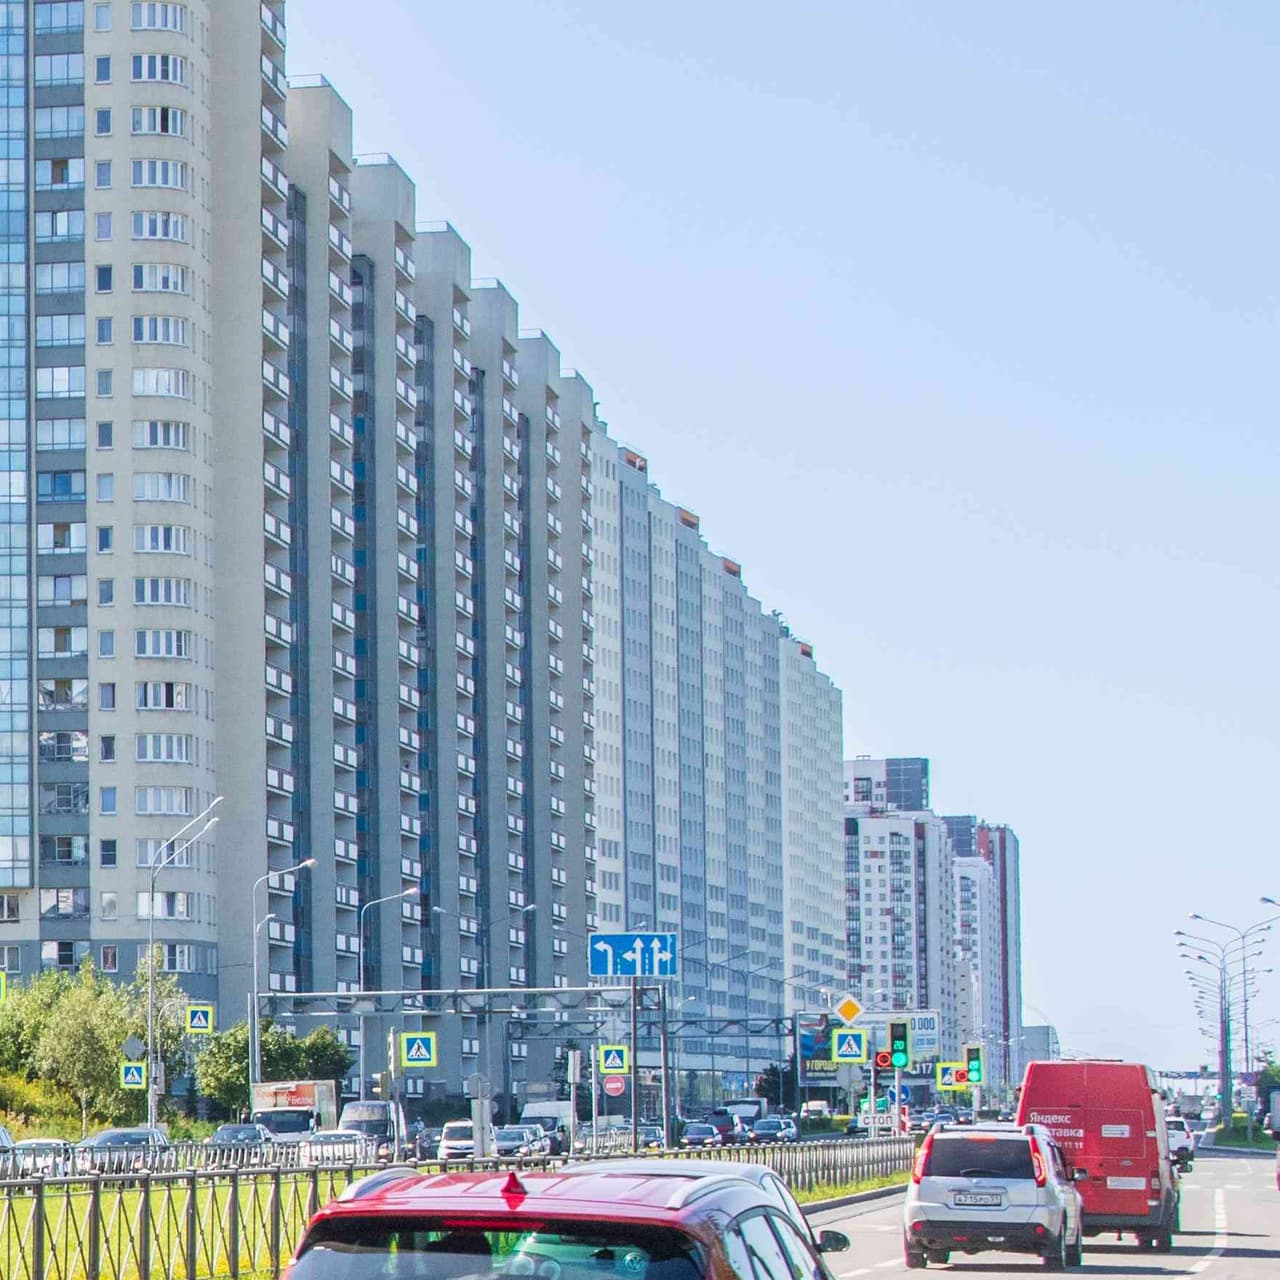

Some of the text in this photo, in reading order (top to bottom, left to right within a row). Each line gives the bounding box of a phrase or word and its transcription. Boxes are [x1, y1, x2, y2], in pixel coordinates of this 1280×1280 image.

[863, 1115, 893, 1126] СТОП
[1030, 1112, 1072, 1124] Яндекс
[1049, 1128, 1084, 1138] тавка
